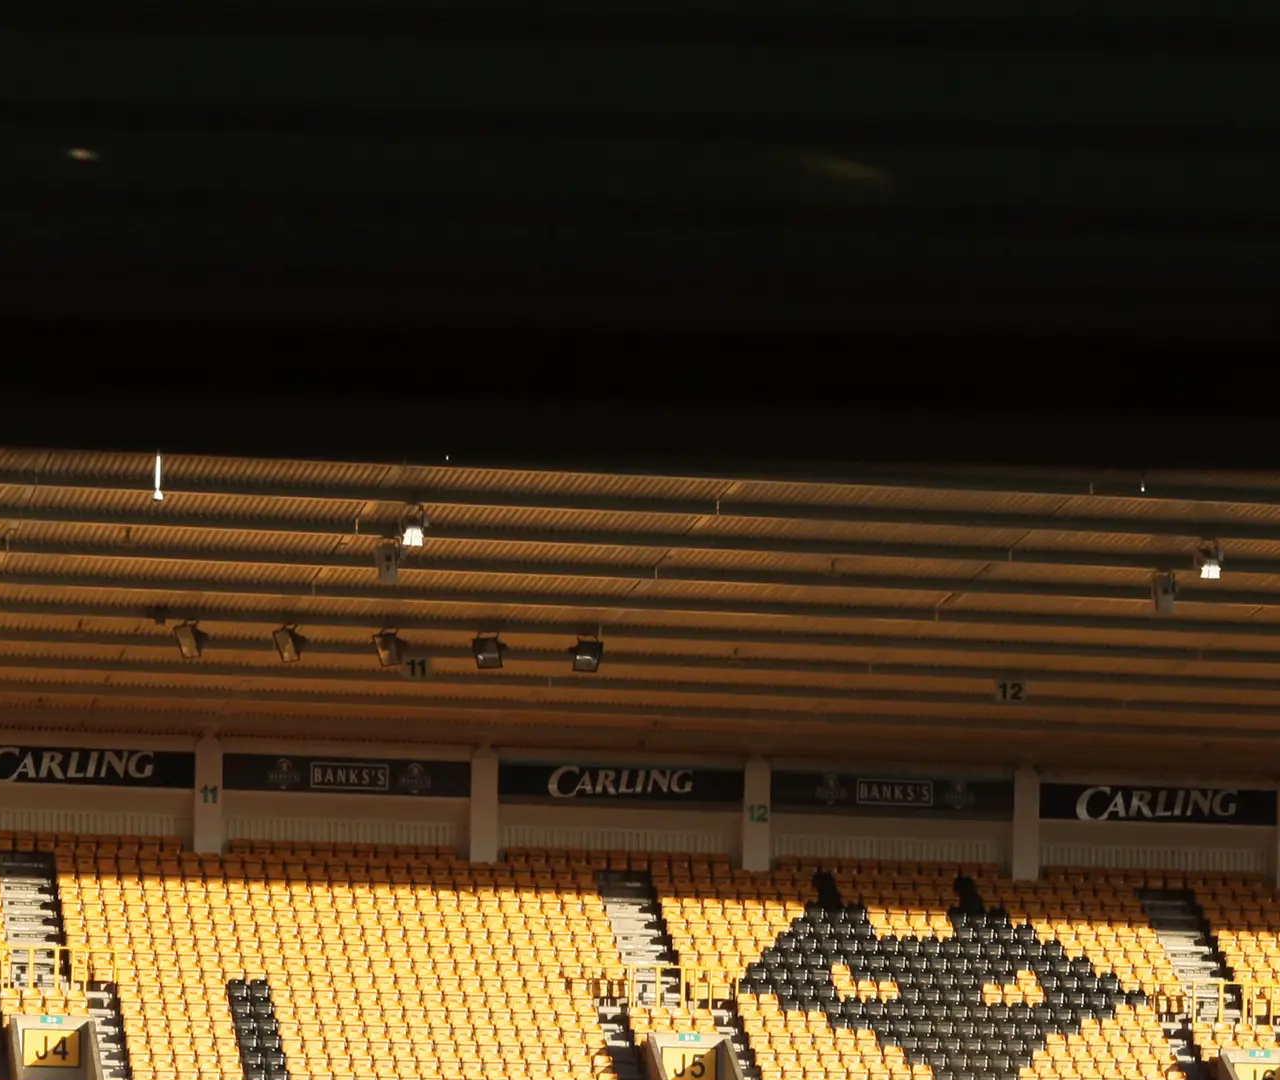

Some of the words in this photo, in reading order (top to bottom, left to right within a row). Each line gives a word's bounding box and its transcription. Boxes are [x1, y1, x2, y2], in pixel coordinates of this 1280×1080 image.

[406, 659, 426, 676] 11
[998, 683, 1022, 700] 12
[314, 767, 385, 786] BANKS'S
[548, 766, 693, 798] CARLING
[201, 786, 218, 803] 11
[860, 784, 930, 803] BANKS'S
[748, 805, 768, 822] 12
[1076, 786, 1238, 822] CARLING
[36, 1036, 69, 1060] J4
[674, 1053, 706, 1078] J5
